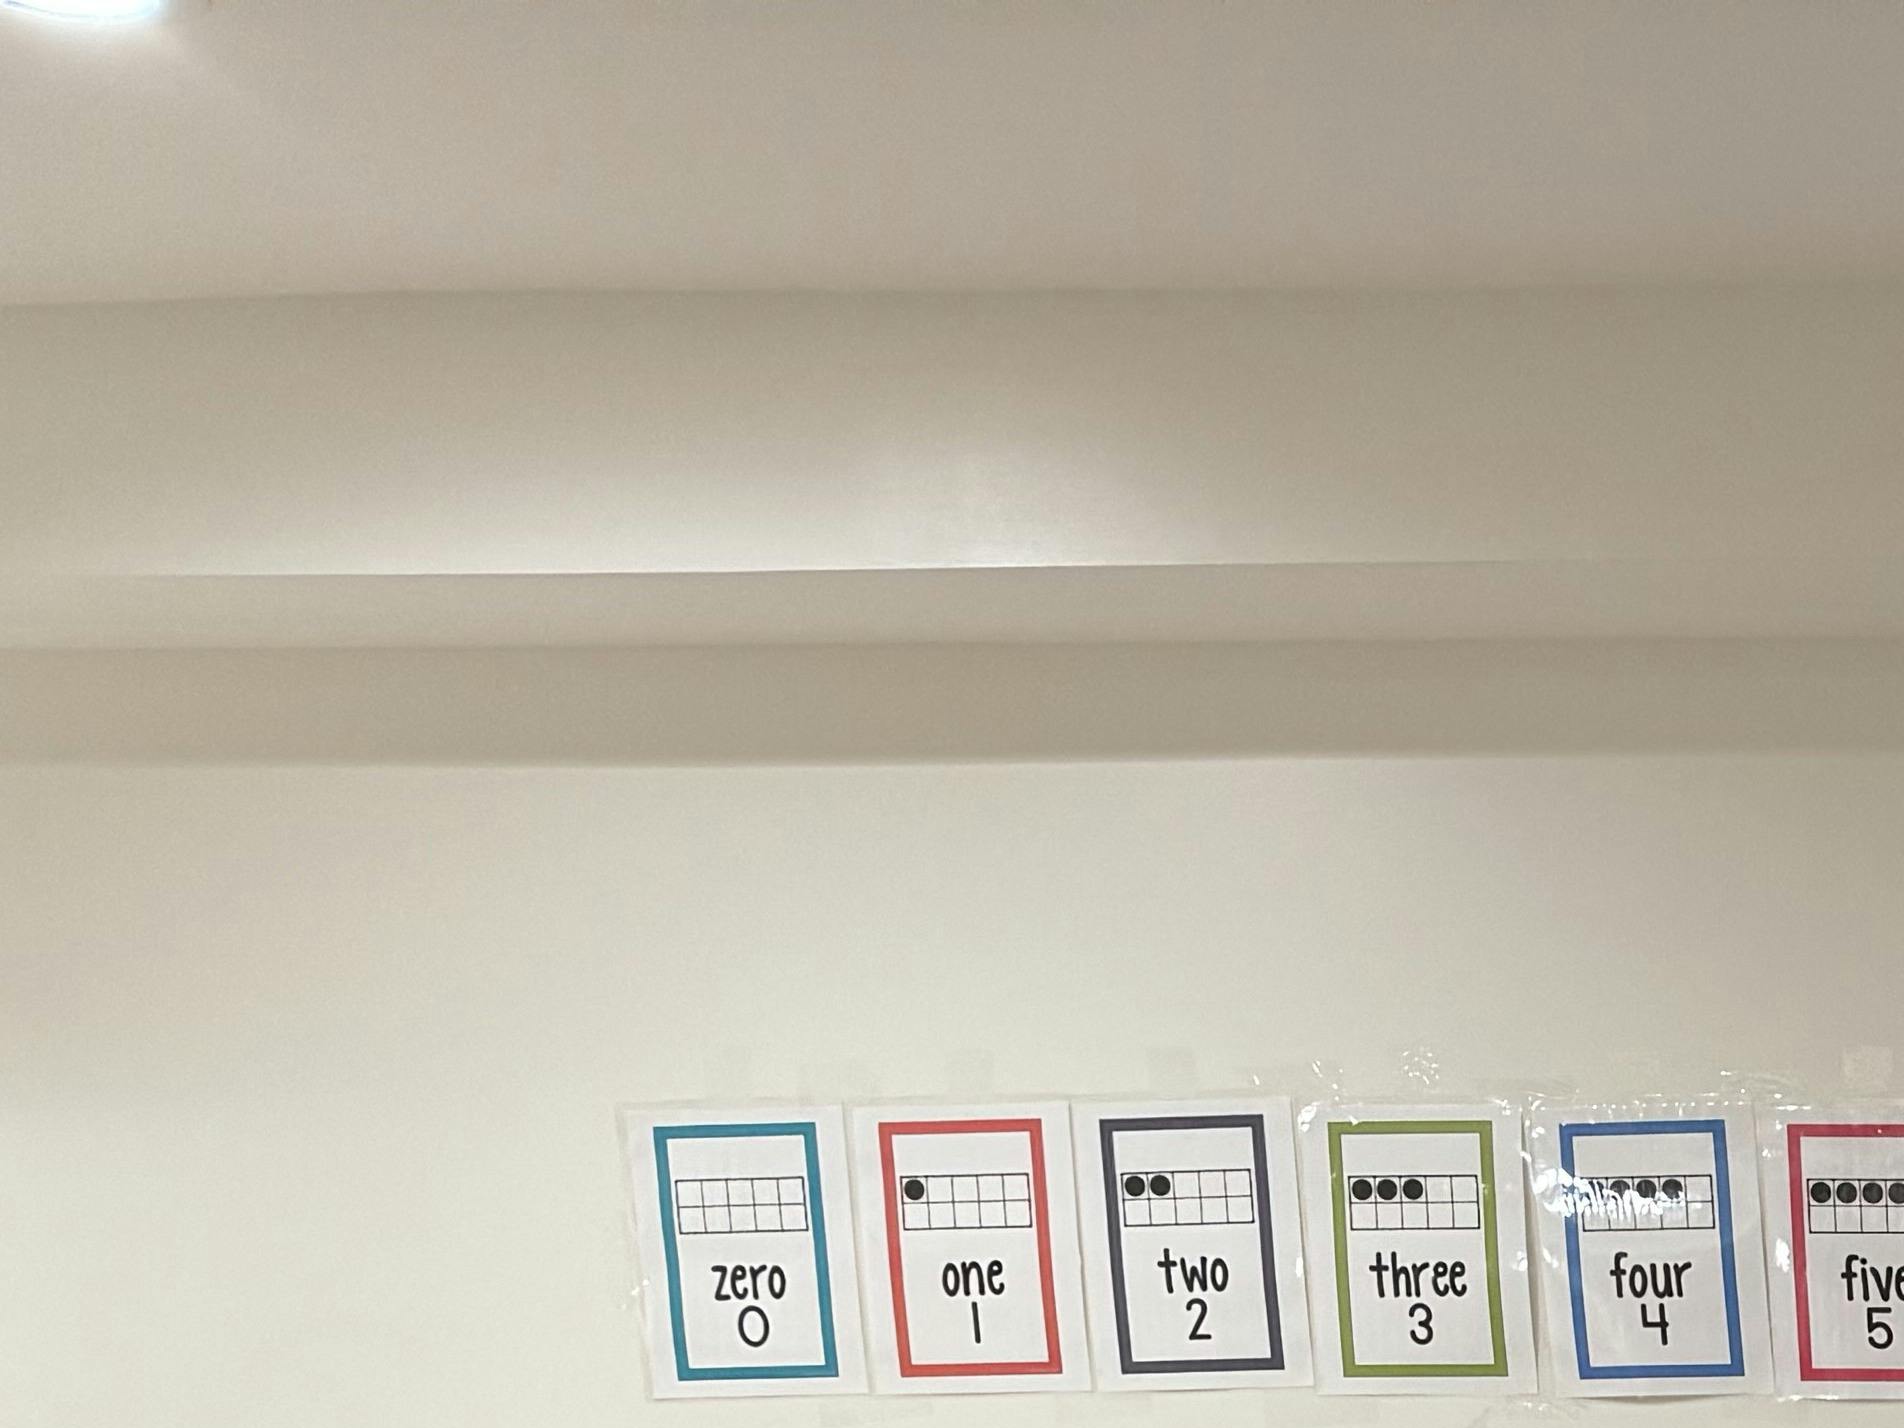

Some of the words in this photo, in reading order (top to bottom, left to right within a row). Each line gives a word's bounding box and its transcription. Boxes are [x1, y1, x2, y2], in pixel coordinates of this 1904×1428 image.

[711, 1264, 786, 1301] zero
[942, 1259, 1005, 1297] one
[1157, 1247, 1229, 1294] two
[1368, 1251, 1468, 1298] three
[1609, 1251, 1692, 1300] four
[737, 1305, 770, 1348] 0
[971, 1301, 981, 1344] 1
[1185, 1298, 1212, 1341] 2
[1408, 1302, 1434, 1346] 3
[1640, 1302, 1670, 1346] 4
[1866, 1306, 1894, 1350] 5
